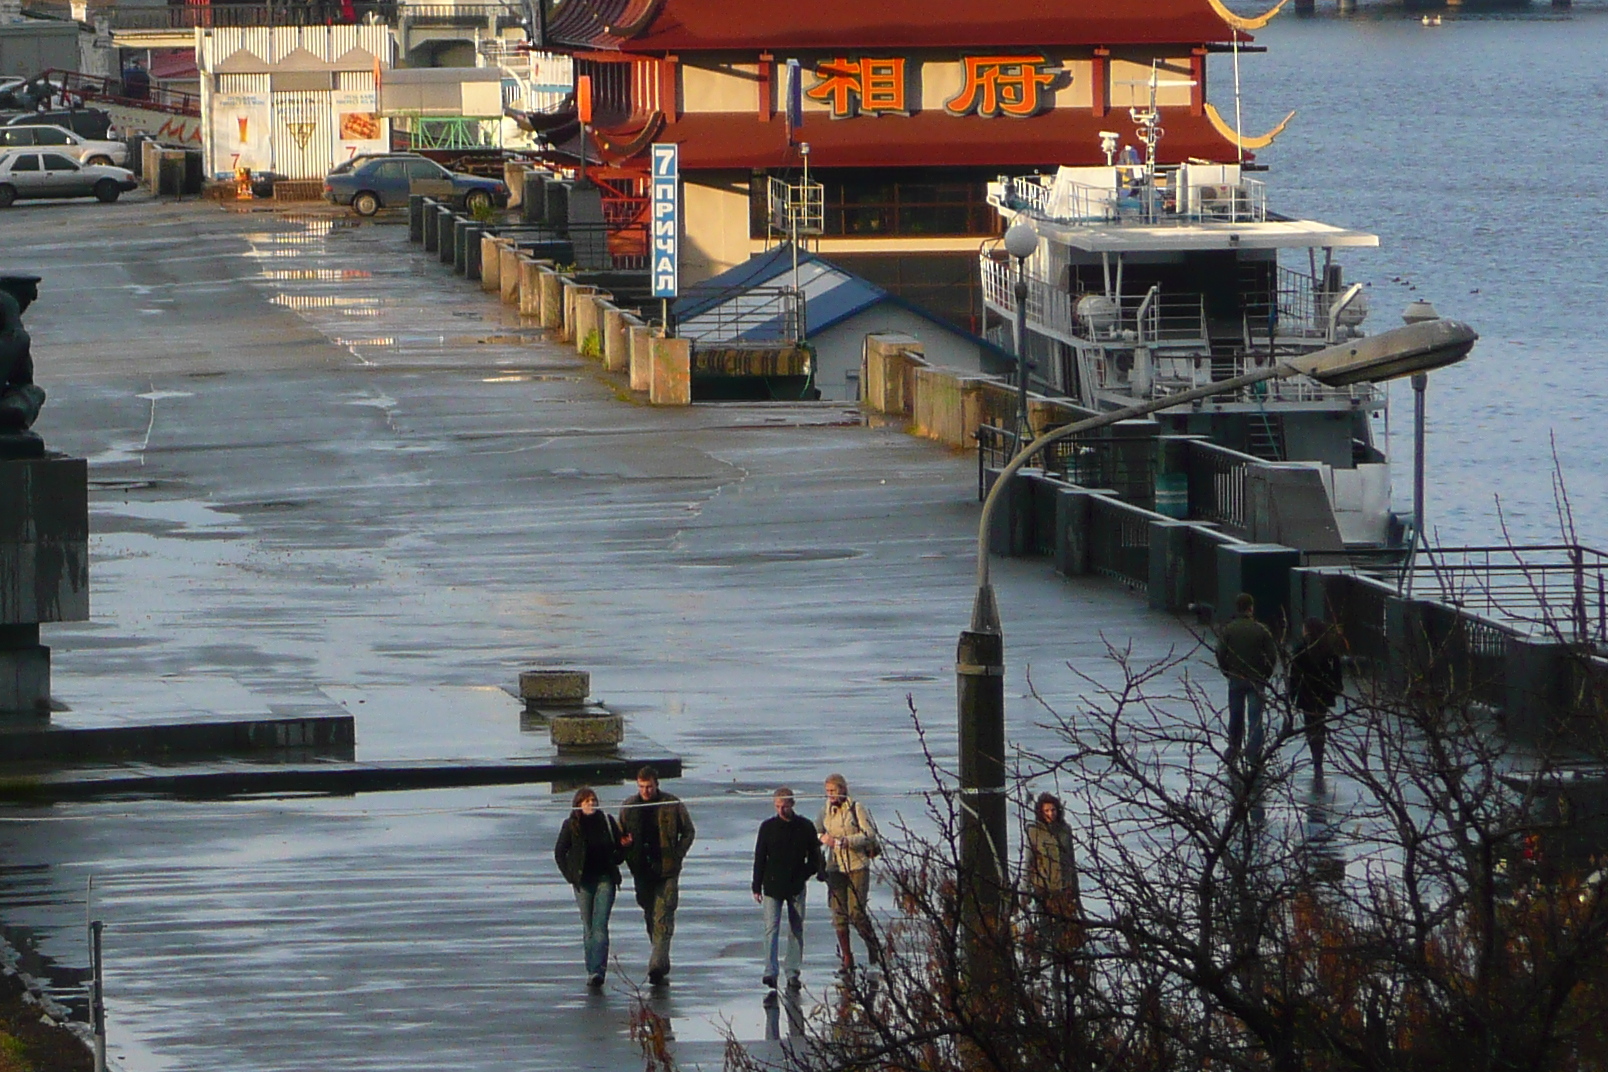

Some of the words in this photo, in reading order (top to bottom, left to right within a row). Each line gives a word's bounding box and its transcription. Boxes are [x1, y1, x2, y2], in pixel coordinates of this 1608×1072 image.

[804, 54, 1057, 118] 相府
[655, 149, 675, 176] 7
[656, 184, 675, 291] ПРИЧАЛ
